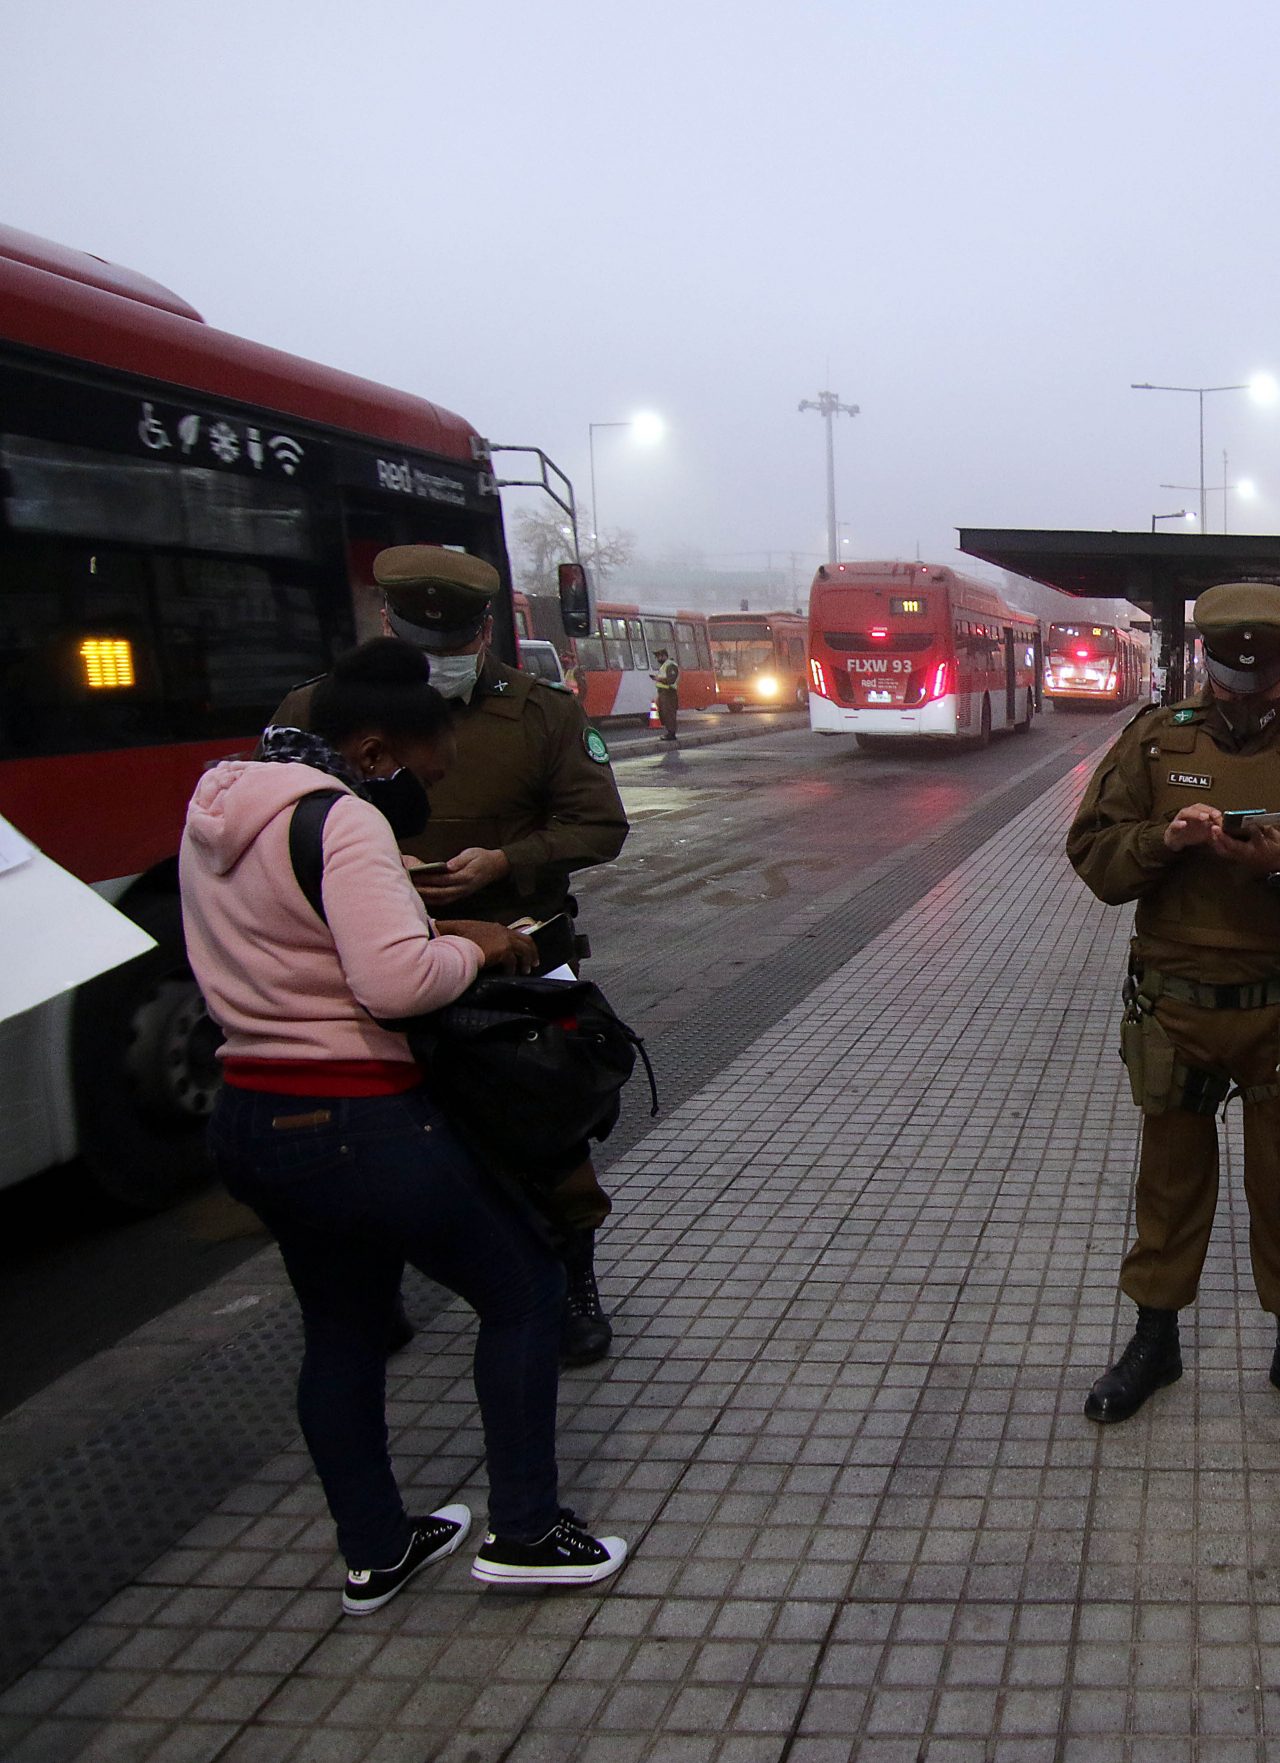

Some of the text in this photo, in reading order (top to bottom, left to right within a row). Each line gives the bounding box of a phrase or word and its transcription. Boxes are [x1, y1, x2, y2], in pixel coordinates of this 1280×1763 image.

[903, 600, 918, 612] 111
[847, 659, 912, 674] FLXW 93
[1178, 775, 1198, 785] FUICA
